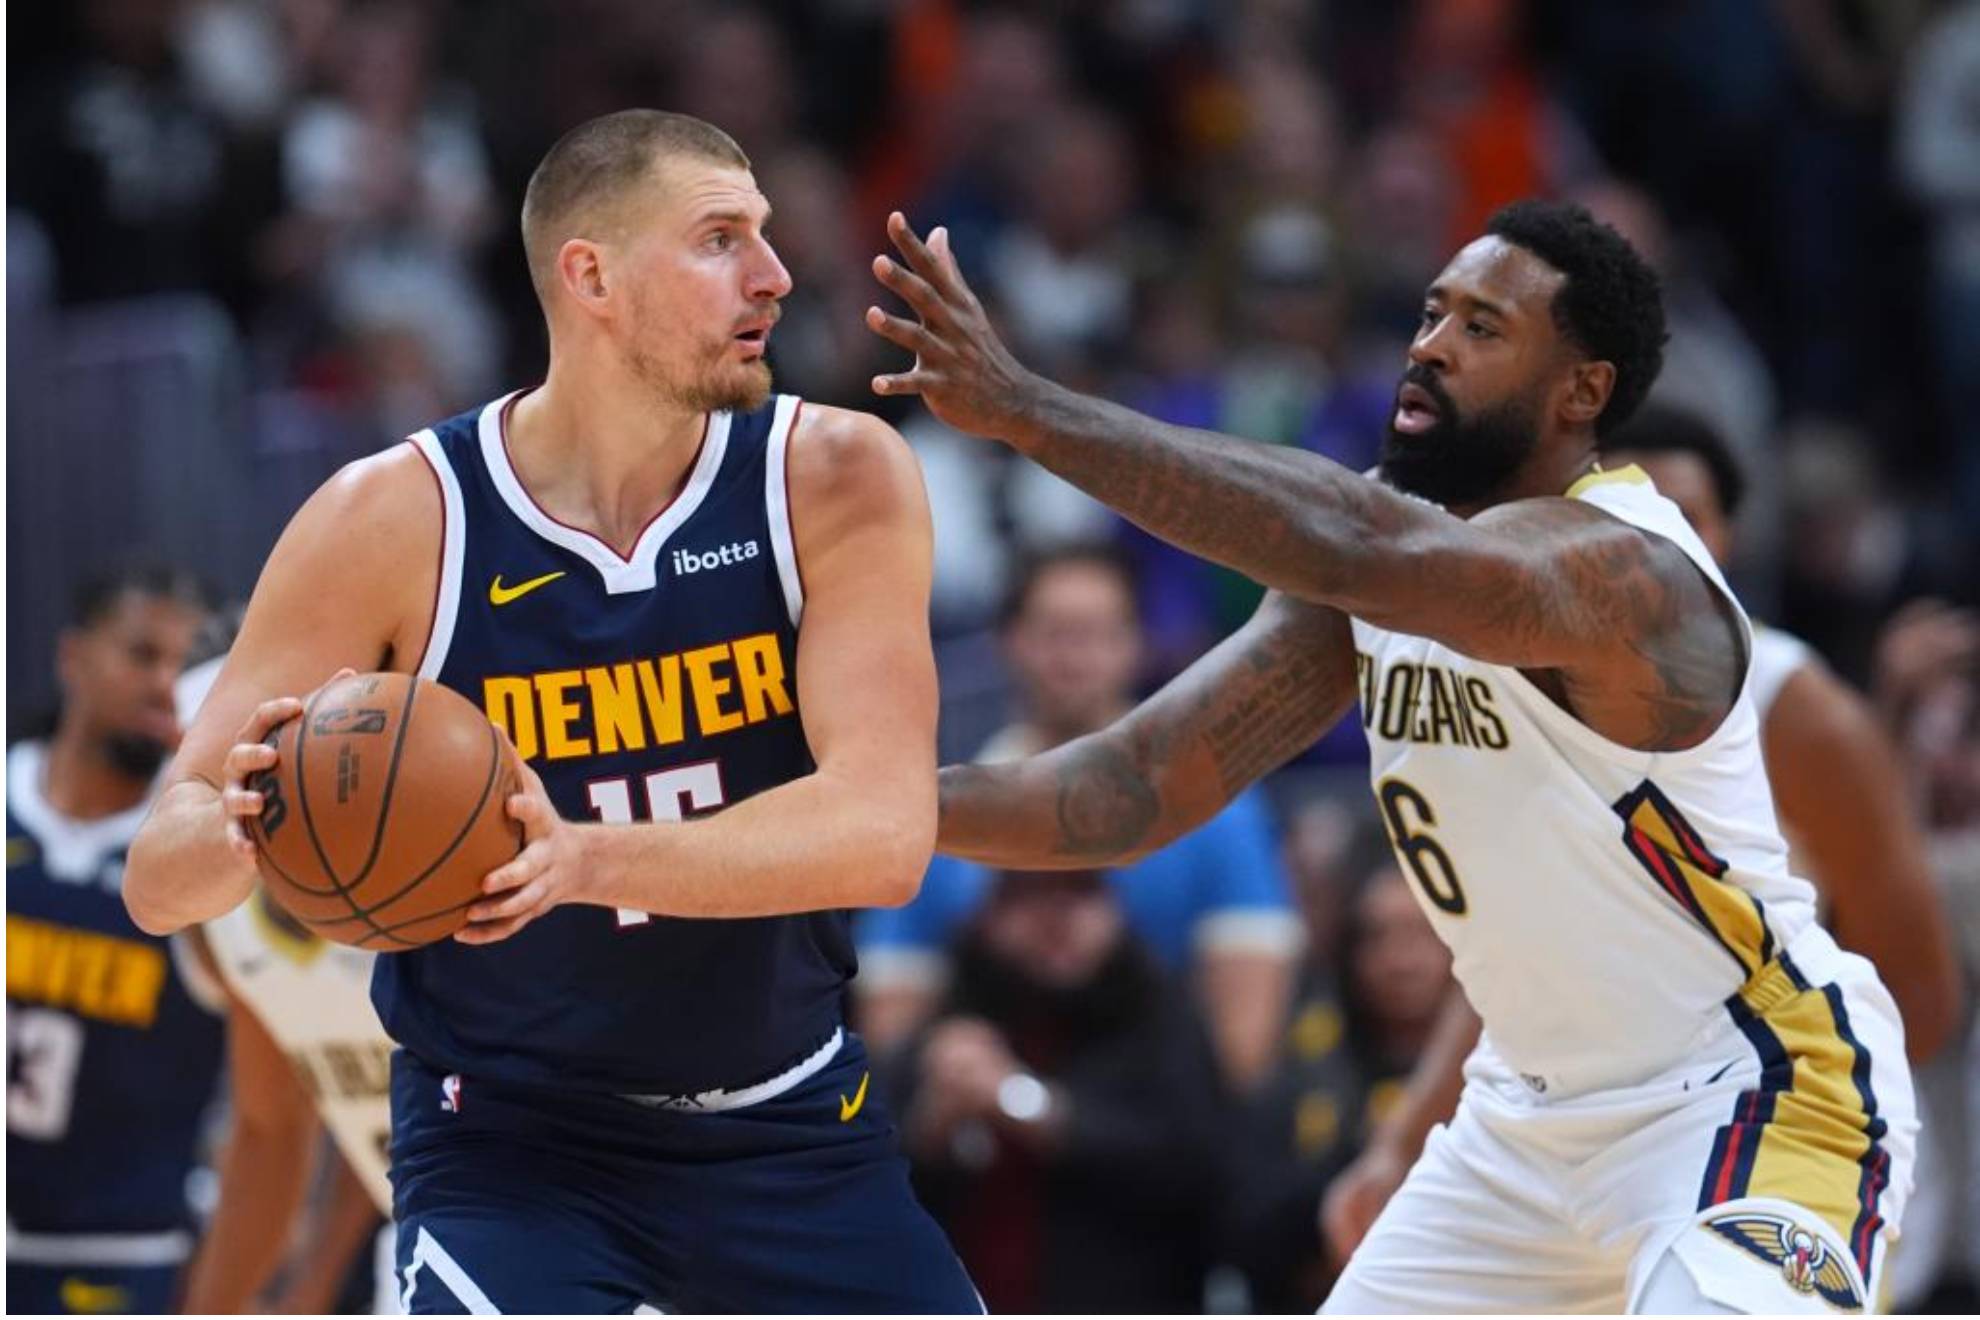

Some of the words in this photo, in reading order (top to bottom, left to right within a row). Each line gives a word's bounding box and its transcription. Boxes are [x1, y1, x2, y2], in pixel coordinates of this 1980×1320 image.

[672, 540, 760, 576] ibotta
[483, 631, 795, 761] DENVER
[1379, 776, 1468, 917] 6
